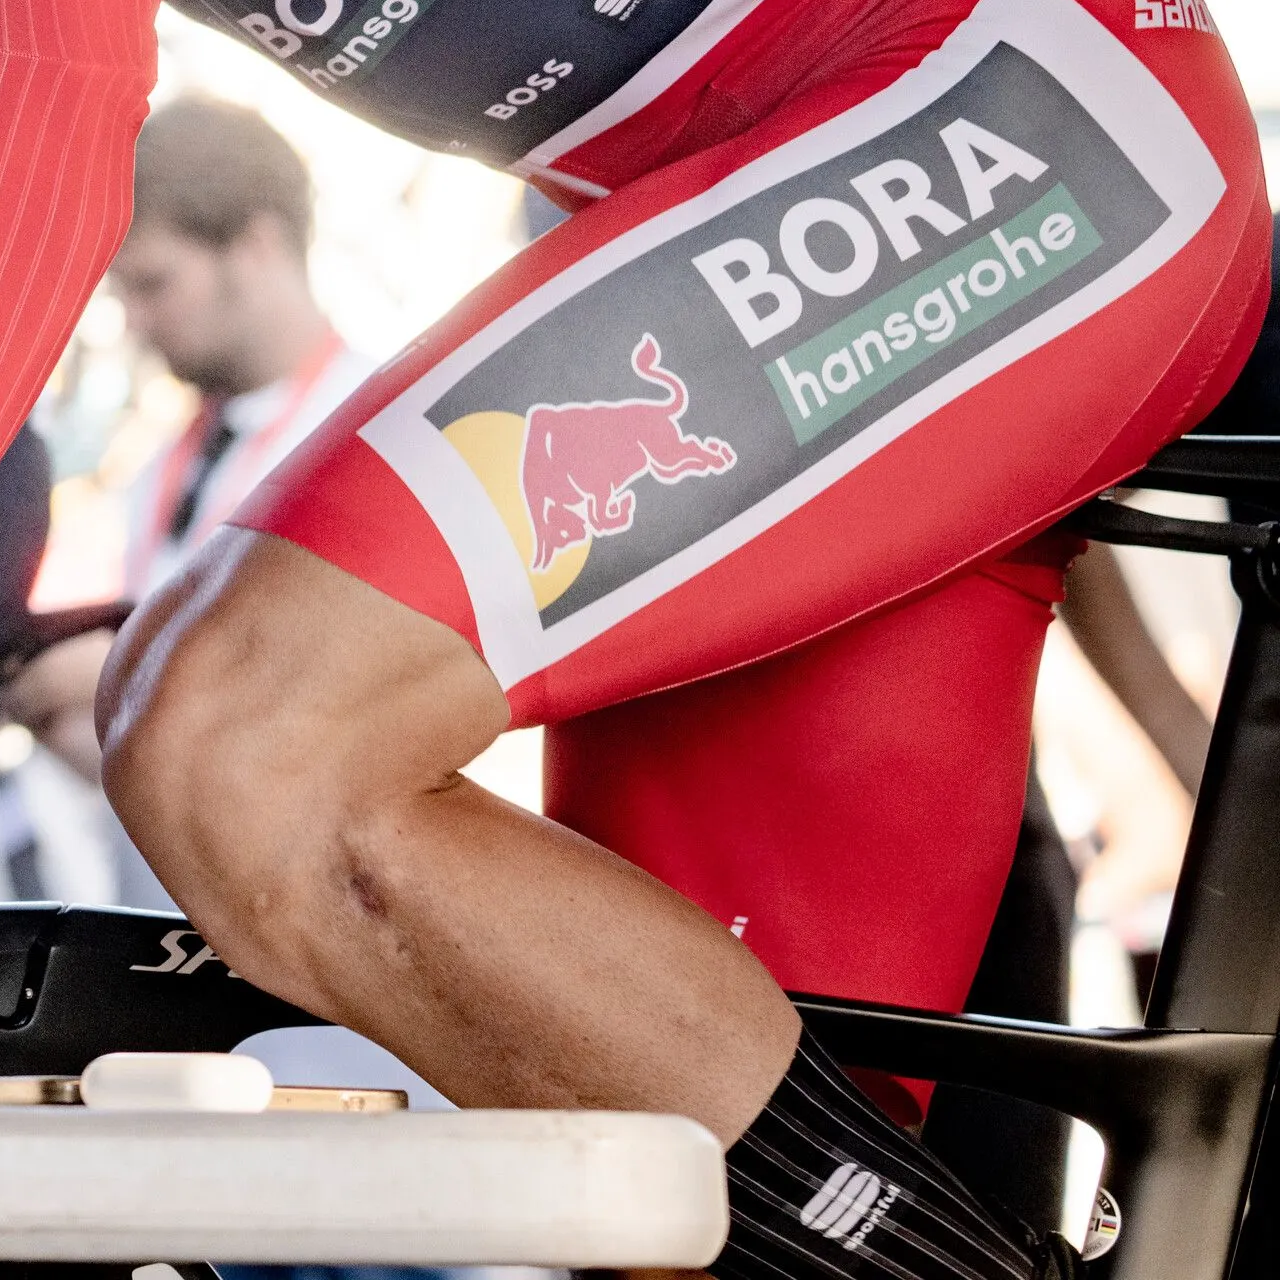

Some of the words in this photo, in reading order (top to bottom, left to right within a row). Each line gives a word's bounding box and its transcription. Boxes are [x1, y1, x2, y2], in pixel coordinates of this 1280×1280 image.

[484, 58, 574, 120] BOSS
[692, 117, 1049, 348] BORA
[777, 213, 1077, 419] hansgrohe
